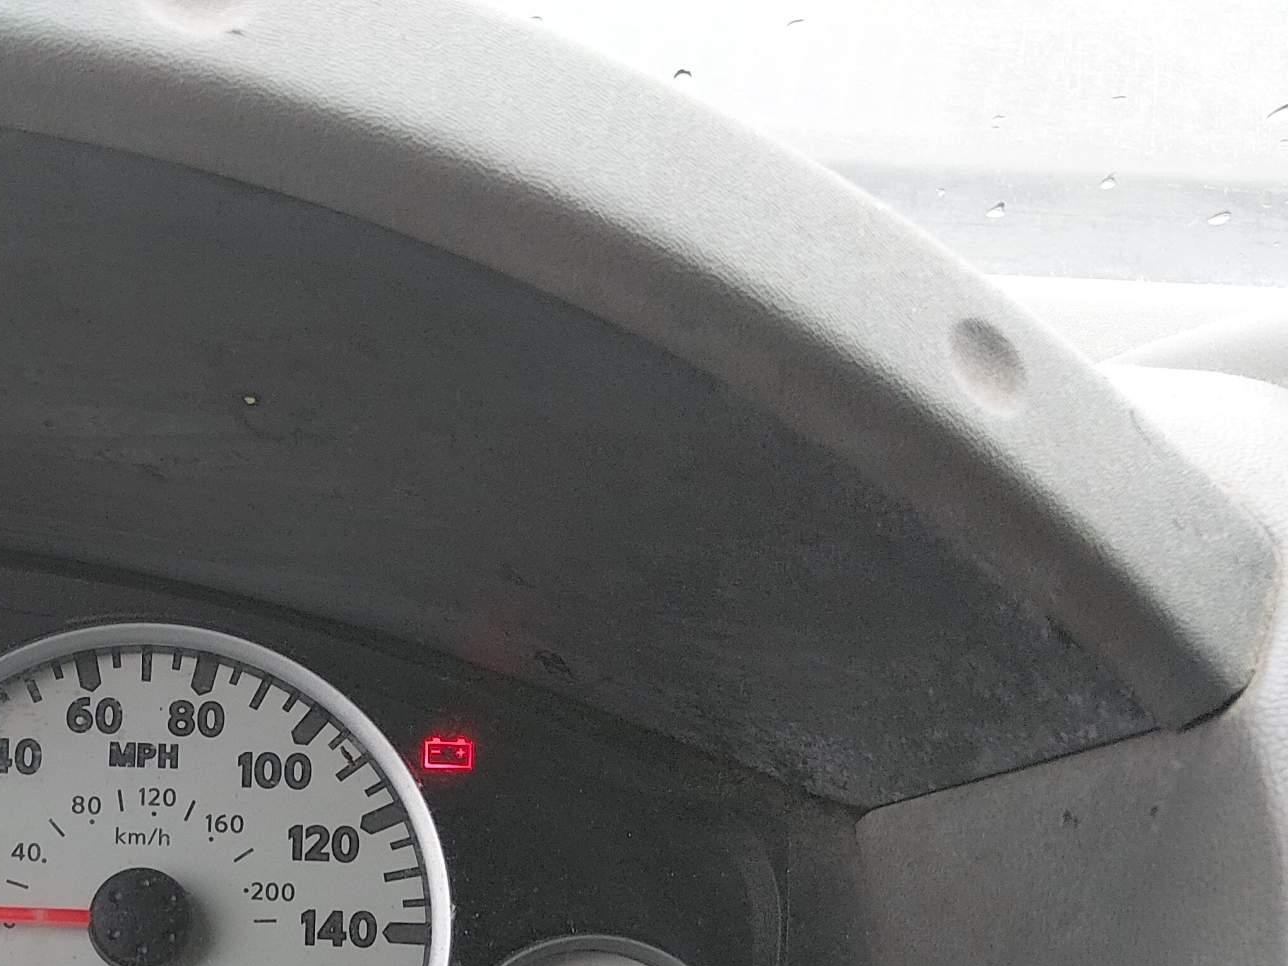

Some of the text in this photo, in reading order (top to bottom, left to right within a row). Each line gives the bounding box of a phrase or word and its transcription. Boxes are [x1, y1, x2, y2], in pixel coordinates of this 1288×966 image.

[66, 698, 123, 734] 60
[168, 701, 225, 738] 80
[109, 742, 179, 769] MPH
[238, 752, 312, 790] 100
[71, 796, 102, 816] 80
[138, 788, 177, 808] 120
[205, 814, 245, 834] 160
[115, 827, 171, 848] km/h
[288, 825, 360, 863] 120
[11, 842, 42, 863] 40
[251, 882, 295, 902] 200
[301, 911, 377, 948] 140
